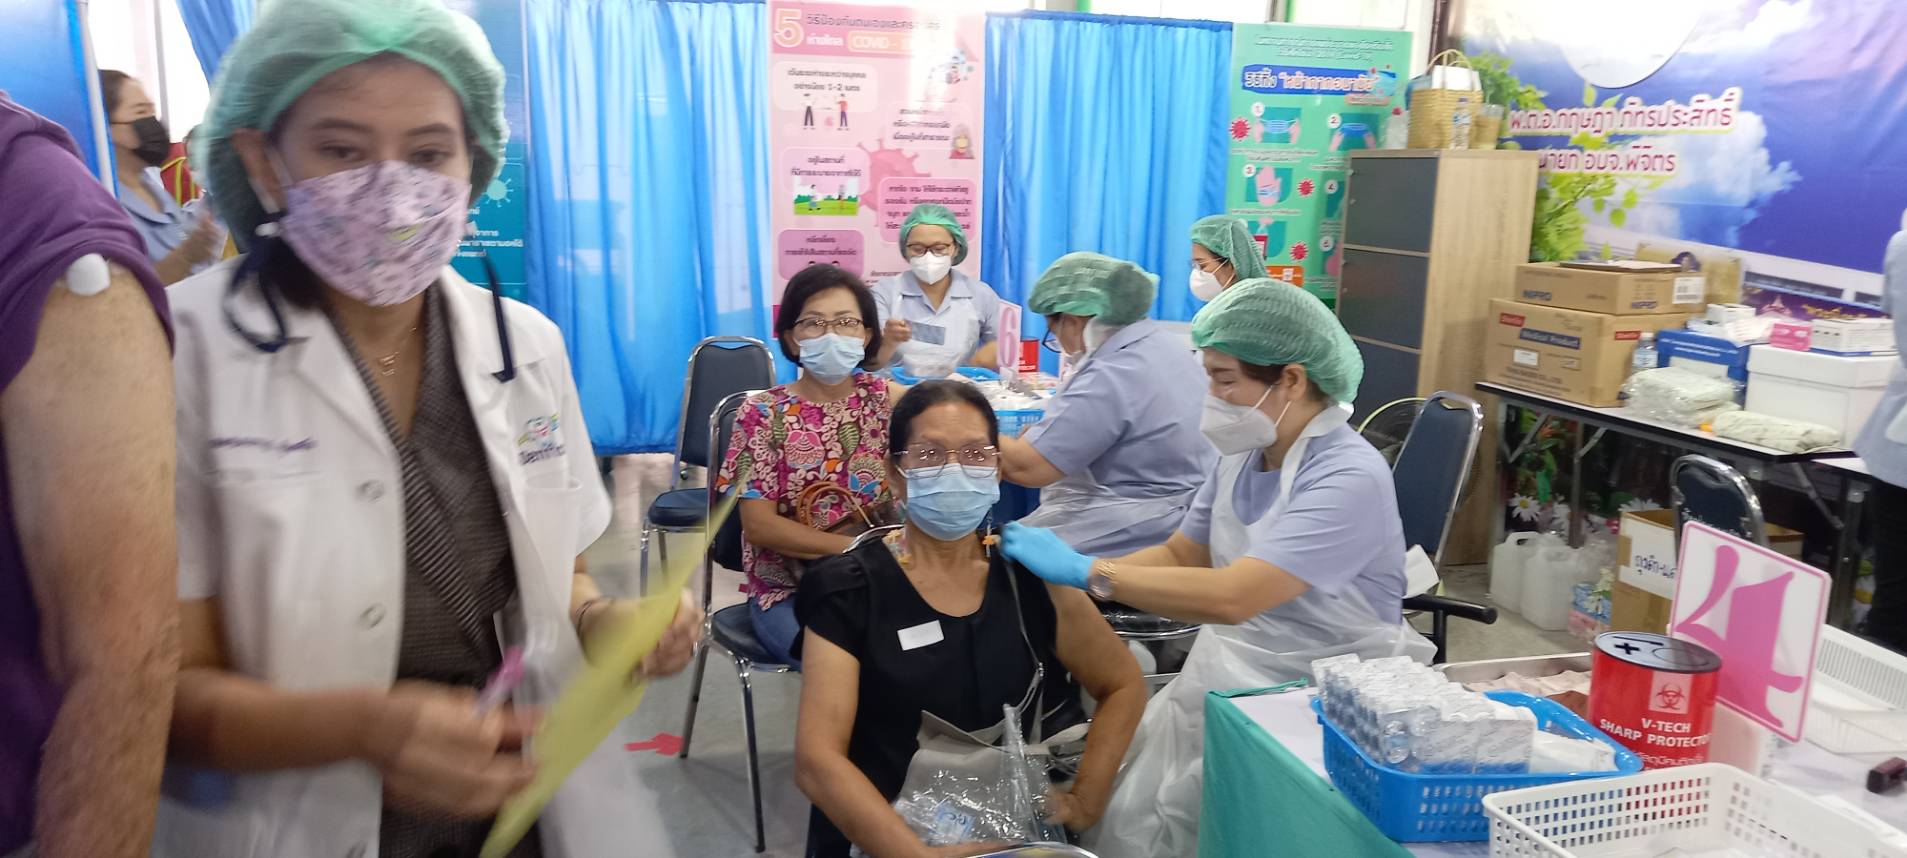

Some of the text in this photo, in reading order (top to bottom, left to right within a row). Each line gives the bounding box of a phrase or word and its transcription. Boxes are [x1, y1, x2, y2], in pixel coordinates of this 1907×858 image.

[774, 8, 803, 47] 5
[999, 307, 1017, 367] 6
[1675, 545, 1804, 728] 4
[1600, 718, 1642, 740] SHARP
[1641, 718, 1691, 733] V-TECH
